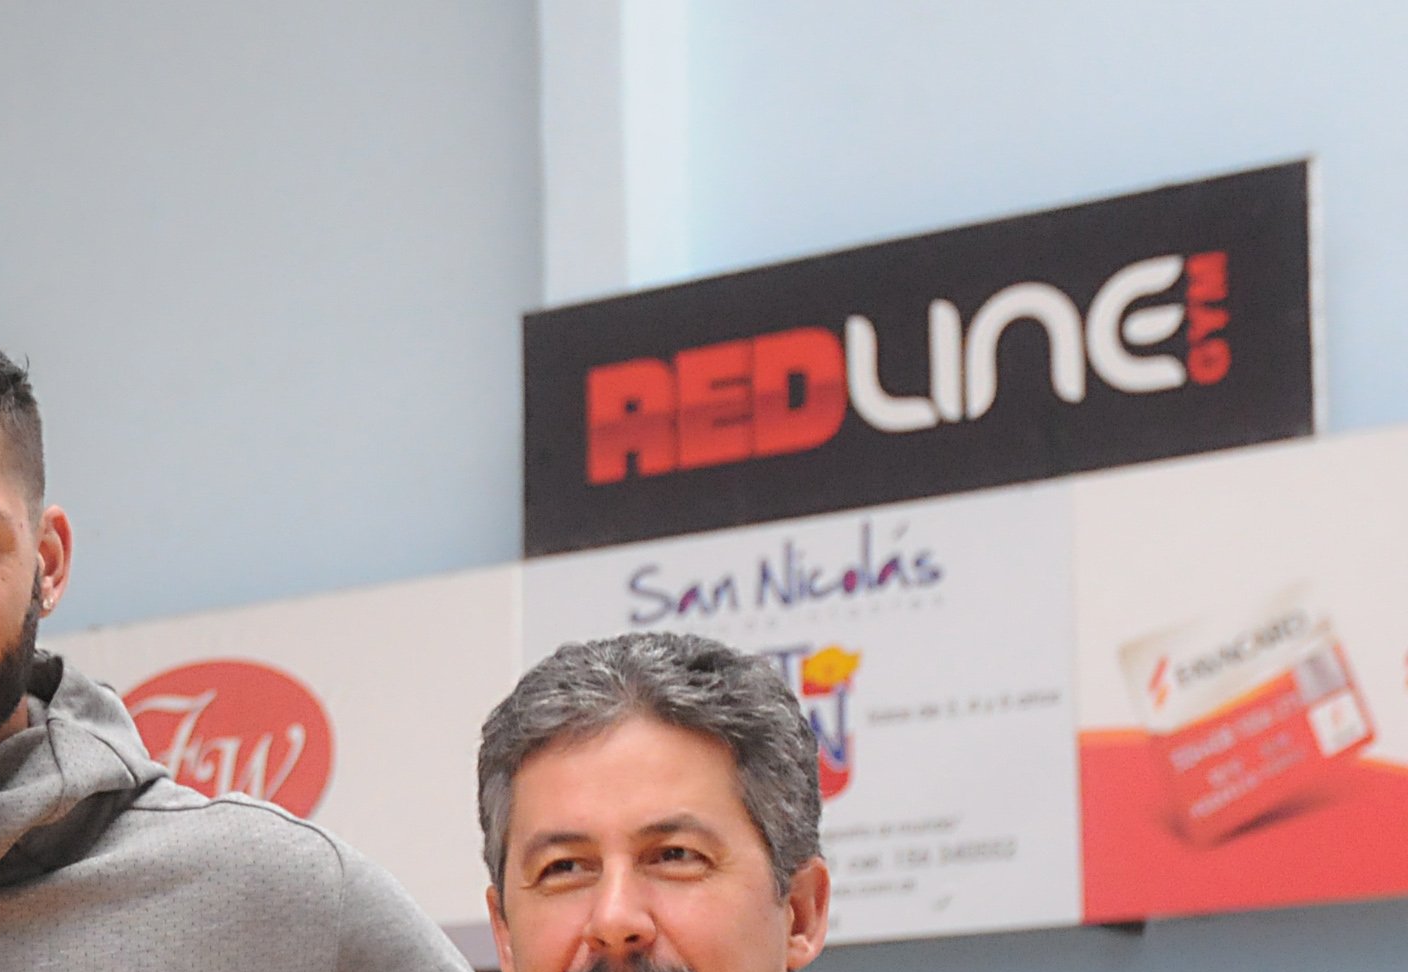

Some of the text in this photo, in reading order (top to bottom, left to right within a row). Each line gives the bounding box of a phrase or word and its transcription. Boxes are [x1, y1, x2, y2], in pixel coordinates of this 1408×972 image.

[1186, 250, 1232, 386] GYM
[628, 562, 739, 625] San
[755, 518, 942, 606] Nicolás
